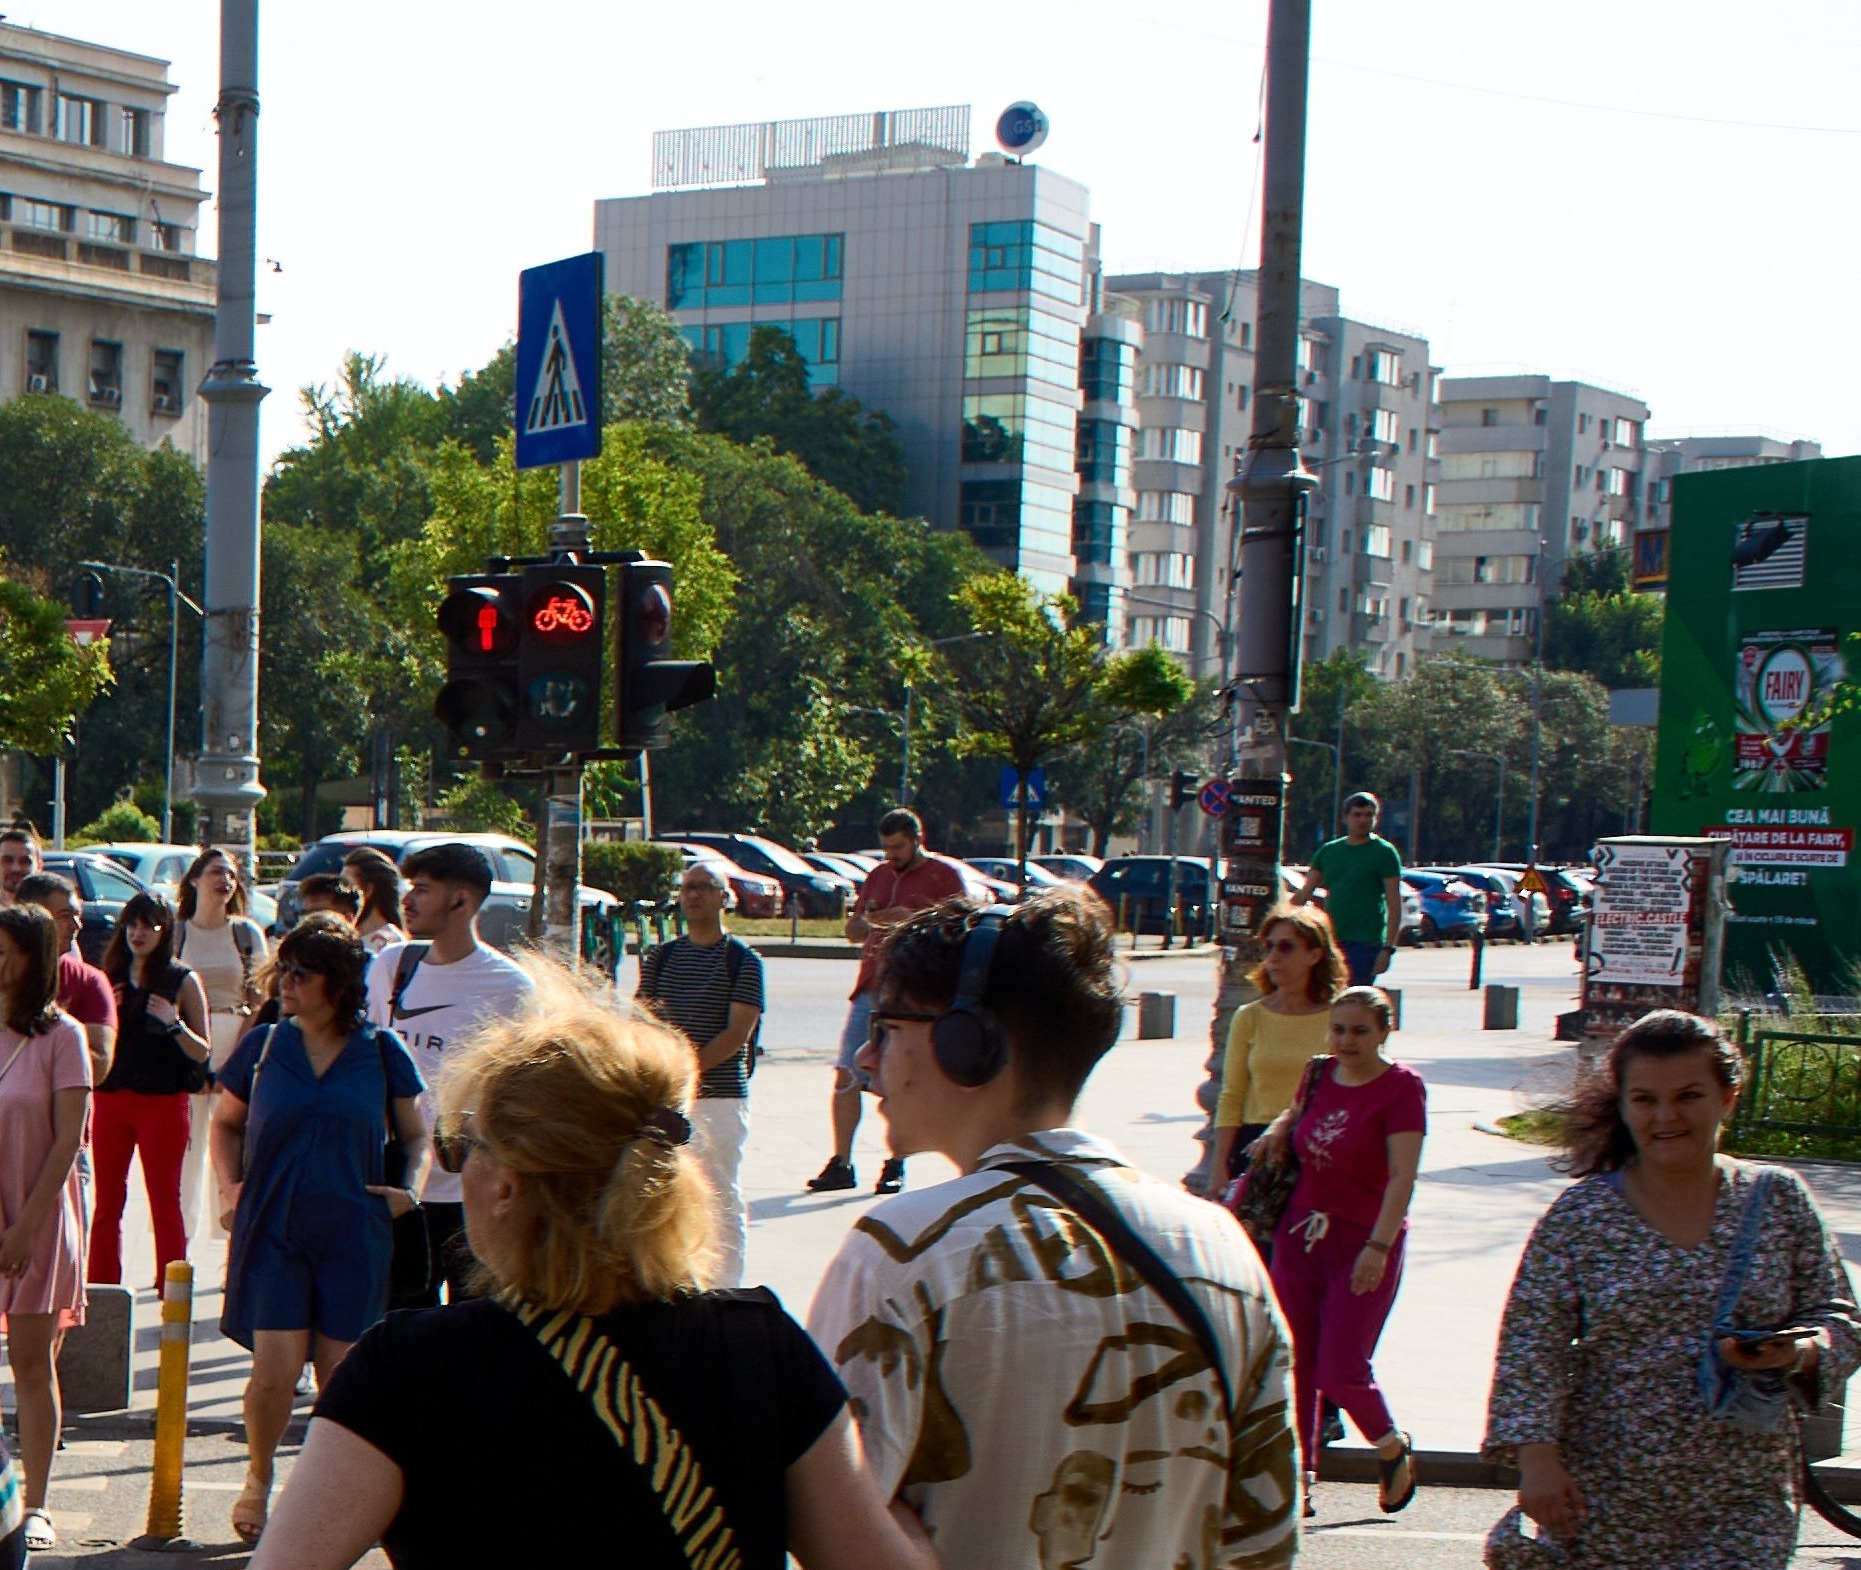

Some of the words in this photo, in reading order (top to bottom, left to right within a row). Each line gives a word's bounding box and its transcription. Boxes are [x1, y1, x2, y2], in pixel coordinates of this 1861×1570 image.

[1765, 671, 1804, 700] FAIRY
[1726, 809, 1754, 823] CEA
[1757, 809, 1785, 824] MAI
[1788, 807, 1830, 825] BUNĂ
[1772, 833, 1786, 844] DE
[1789, 834, 1804, 844] LA
